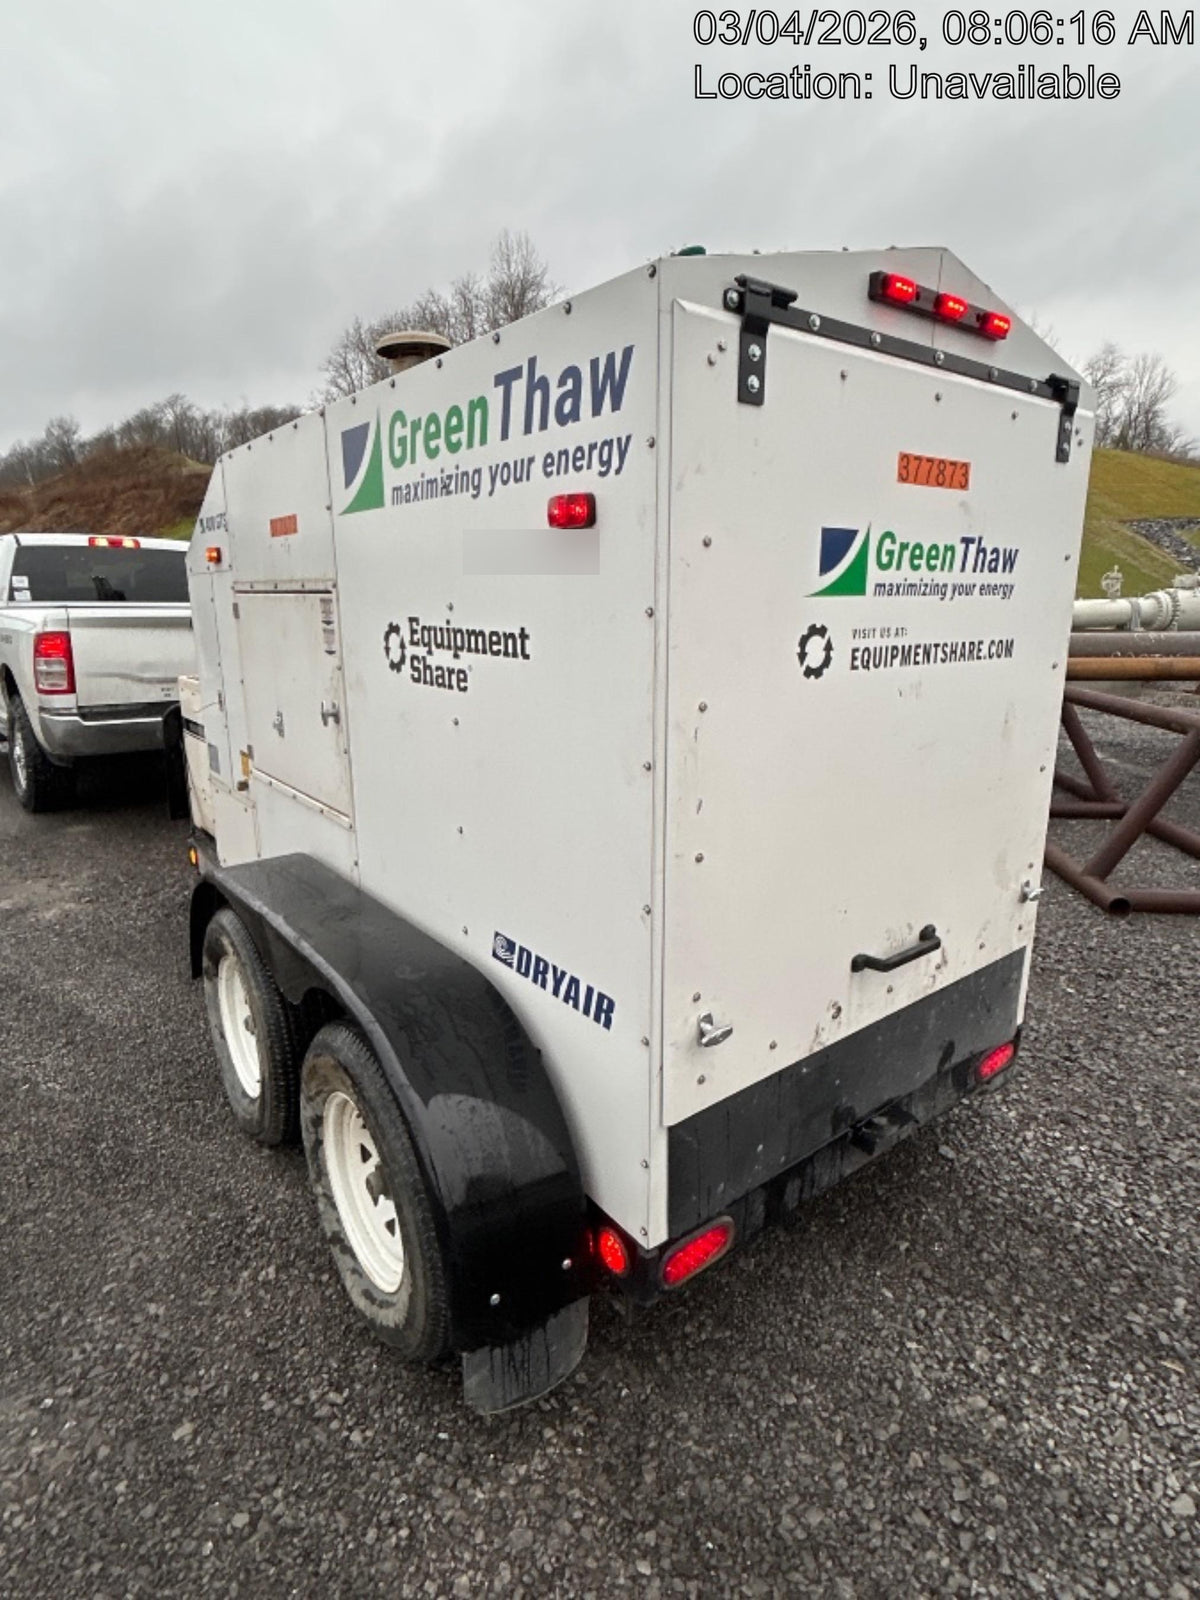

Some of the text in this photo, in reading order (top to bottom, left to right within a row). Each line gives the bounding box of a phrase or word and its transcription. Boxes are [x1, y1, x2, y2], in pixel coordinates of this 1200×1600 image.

[391, 434, 632, 506] maximizing your energy
[899, 454, 969, 490] 377873
[873, 578, 1015, 601] maximizing your energy
[408, 616, 530, 660] Equipment
[852, 627, 907, 640] VISIT US AT:
[410, 654, 468, 693] Share
[850, 638, 1014, 672] EQUIPMENTSHARE.COM
[515, 945, 616, 1032] DRYAIR
